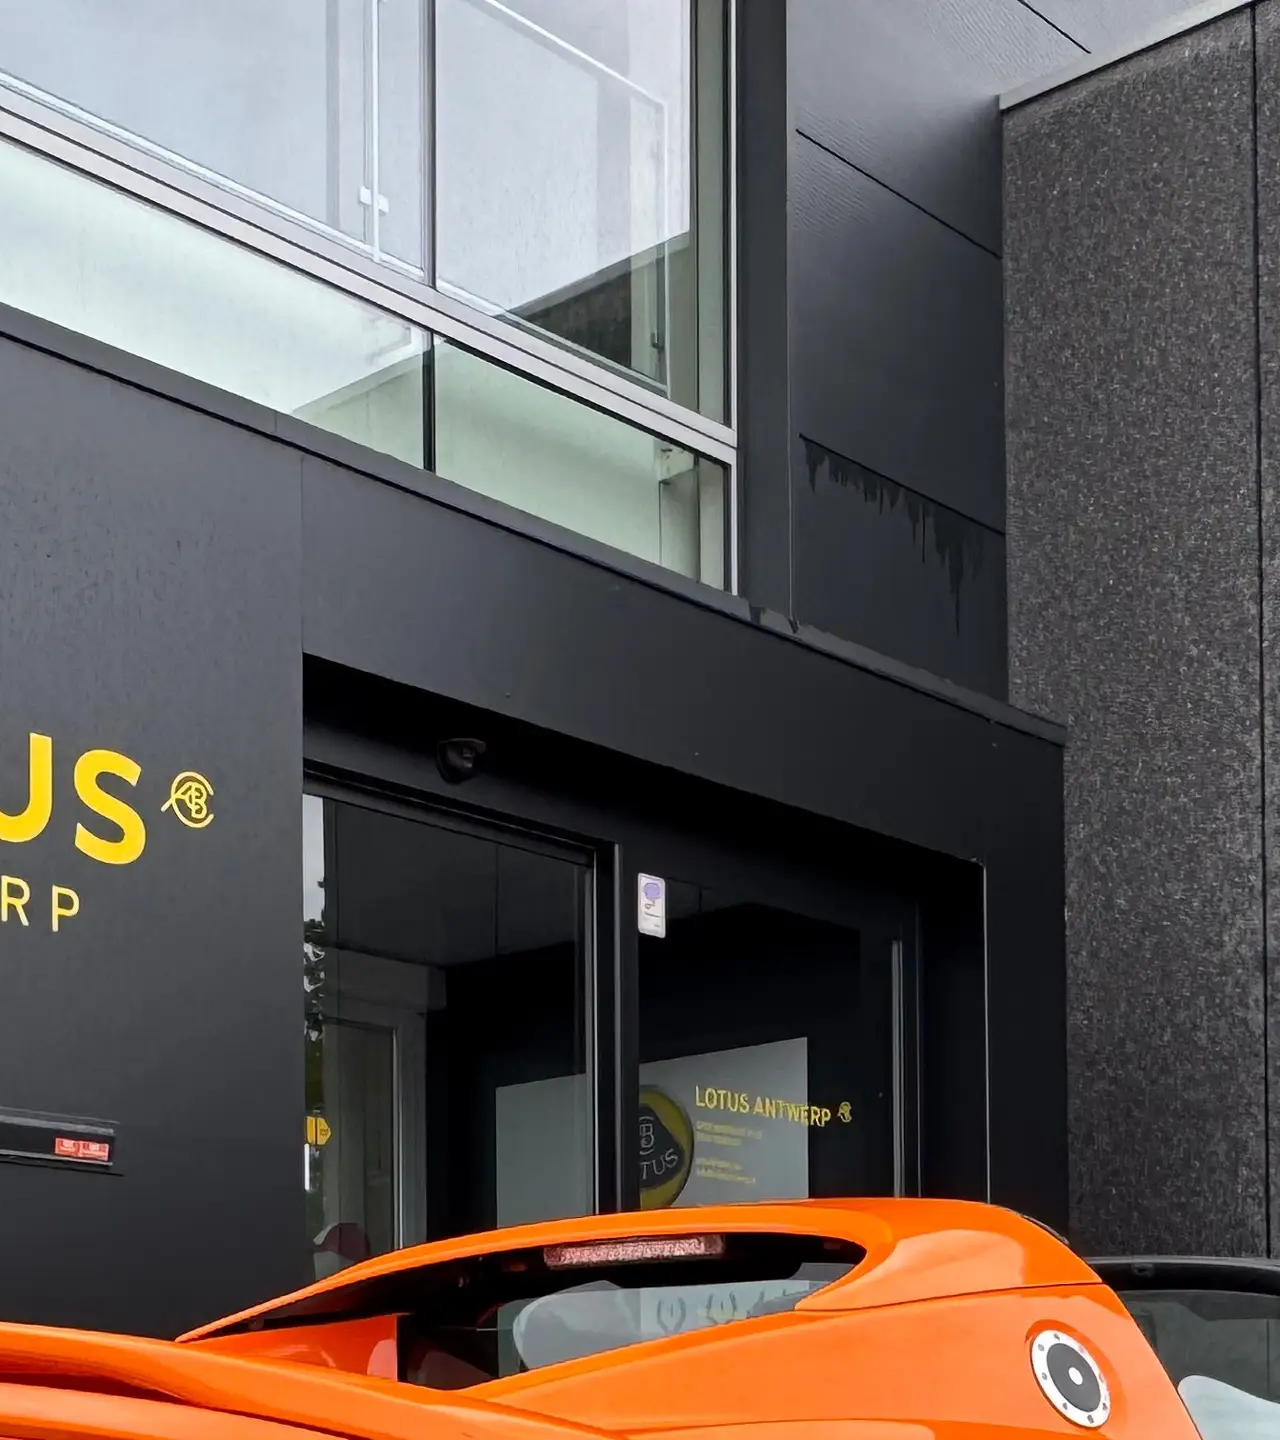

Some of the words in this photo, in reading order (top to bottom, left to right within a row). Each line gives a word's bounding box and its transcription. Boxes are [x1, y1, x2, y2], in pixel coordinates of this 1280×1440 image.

[694, 1085, 750, 1115] LOTUS
[753, 1096, 832, 1128] ANTWERP
[639, 1148, 679, 1181] TUS
